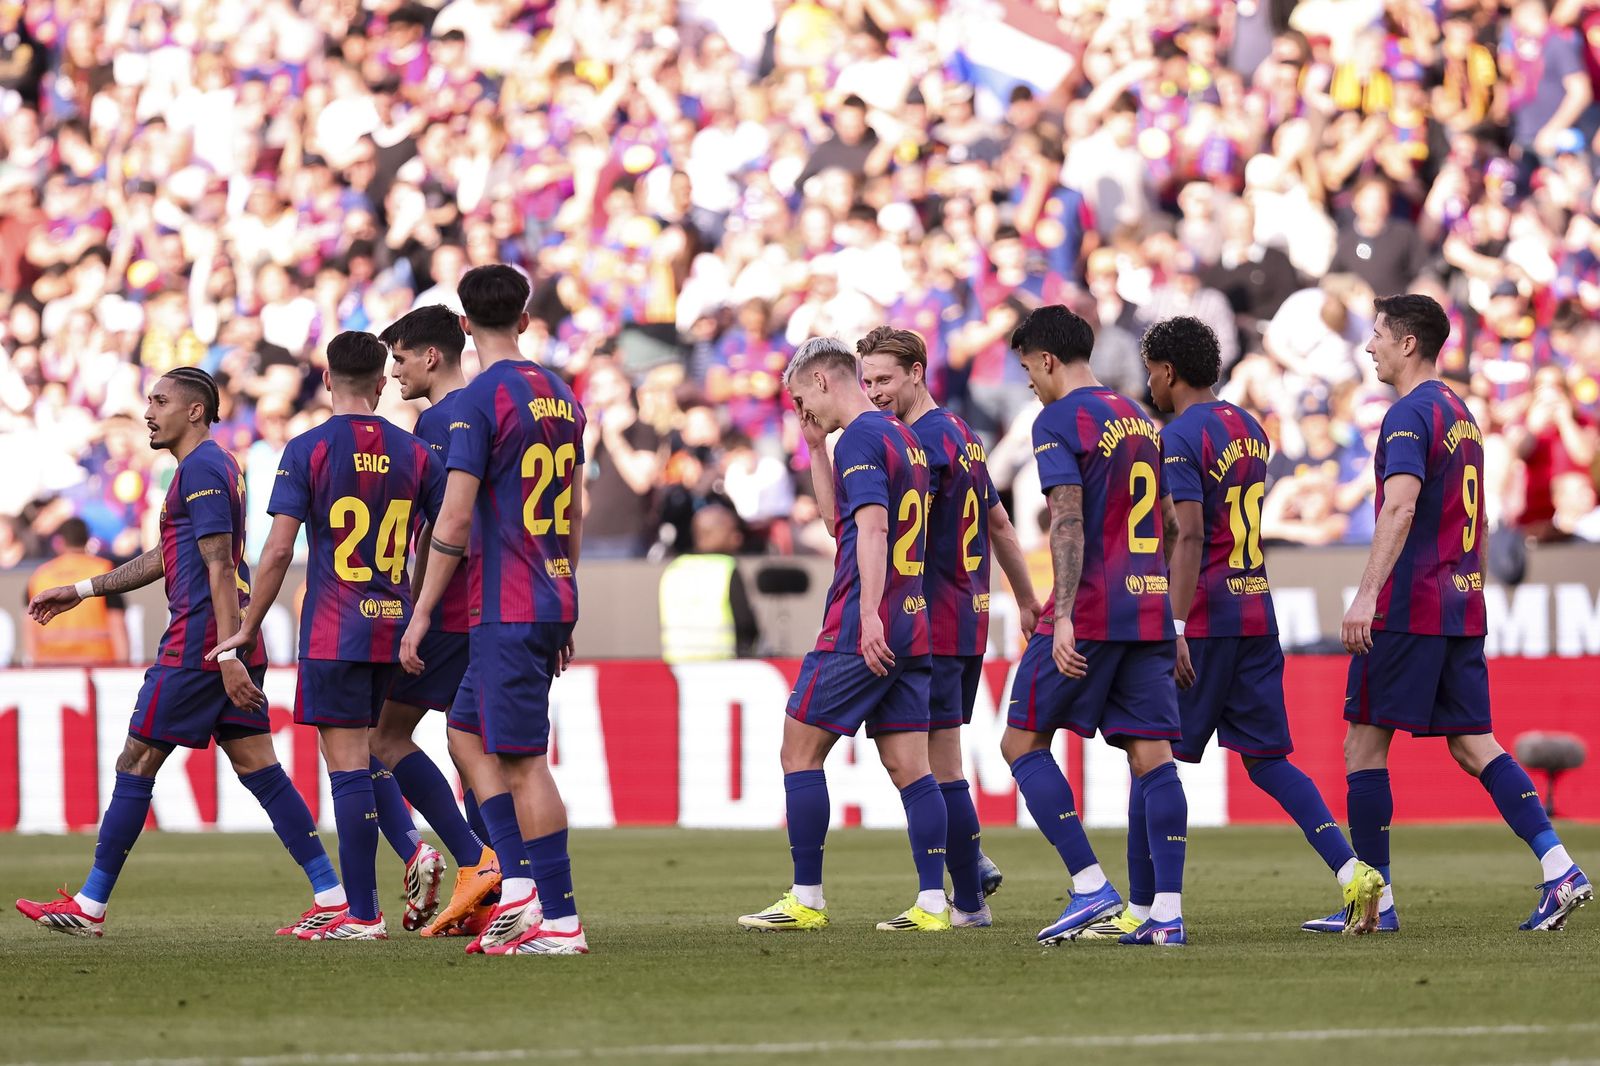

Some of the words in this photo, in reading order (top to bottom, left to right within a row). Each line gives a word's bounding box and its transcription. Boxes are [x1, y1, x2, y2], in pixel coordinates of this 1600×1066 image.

[528, 398, 576, 423] BERNAL
[1097, 419, 1125, 457] JOÃO
[1208, 438, 1245, 483] LAMINE
[353, 452, 390, 474] ERIC
[521, 442, 576, 536] 22
[1127, 461, 1160, 554] 2
[1462, 464, 1478, 553] 9
[329, 496, 412, 585] 24
[1225, 481, 1265, 570] 10
[379, 599, 402, 608] UNHCR
[381, 607, 404, 616] ACNUR
